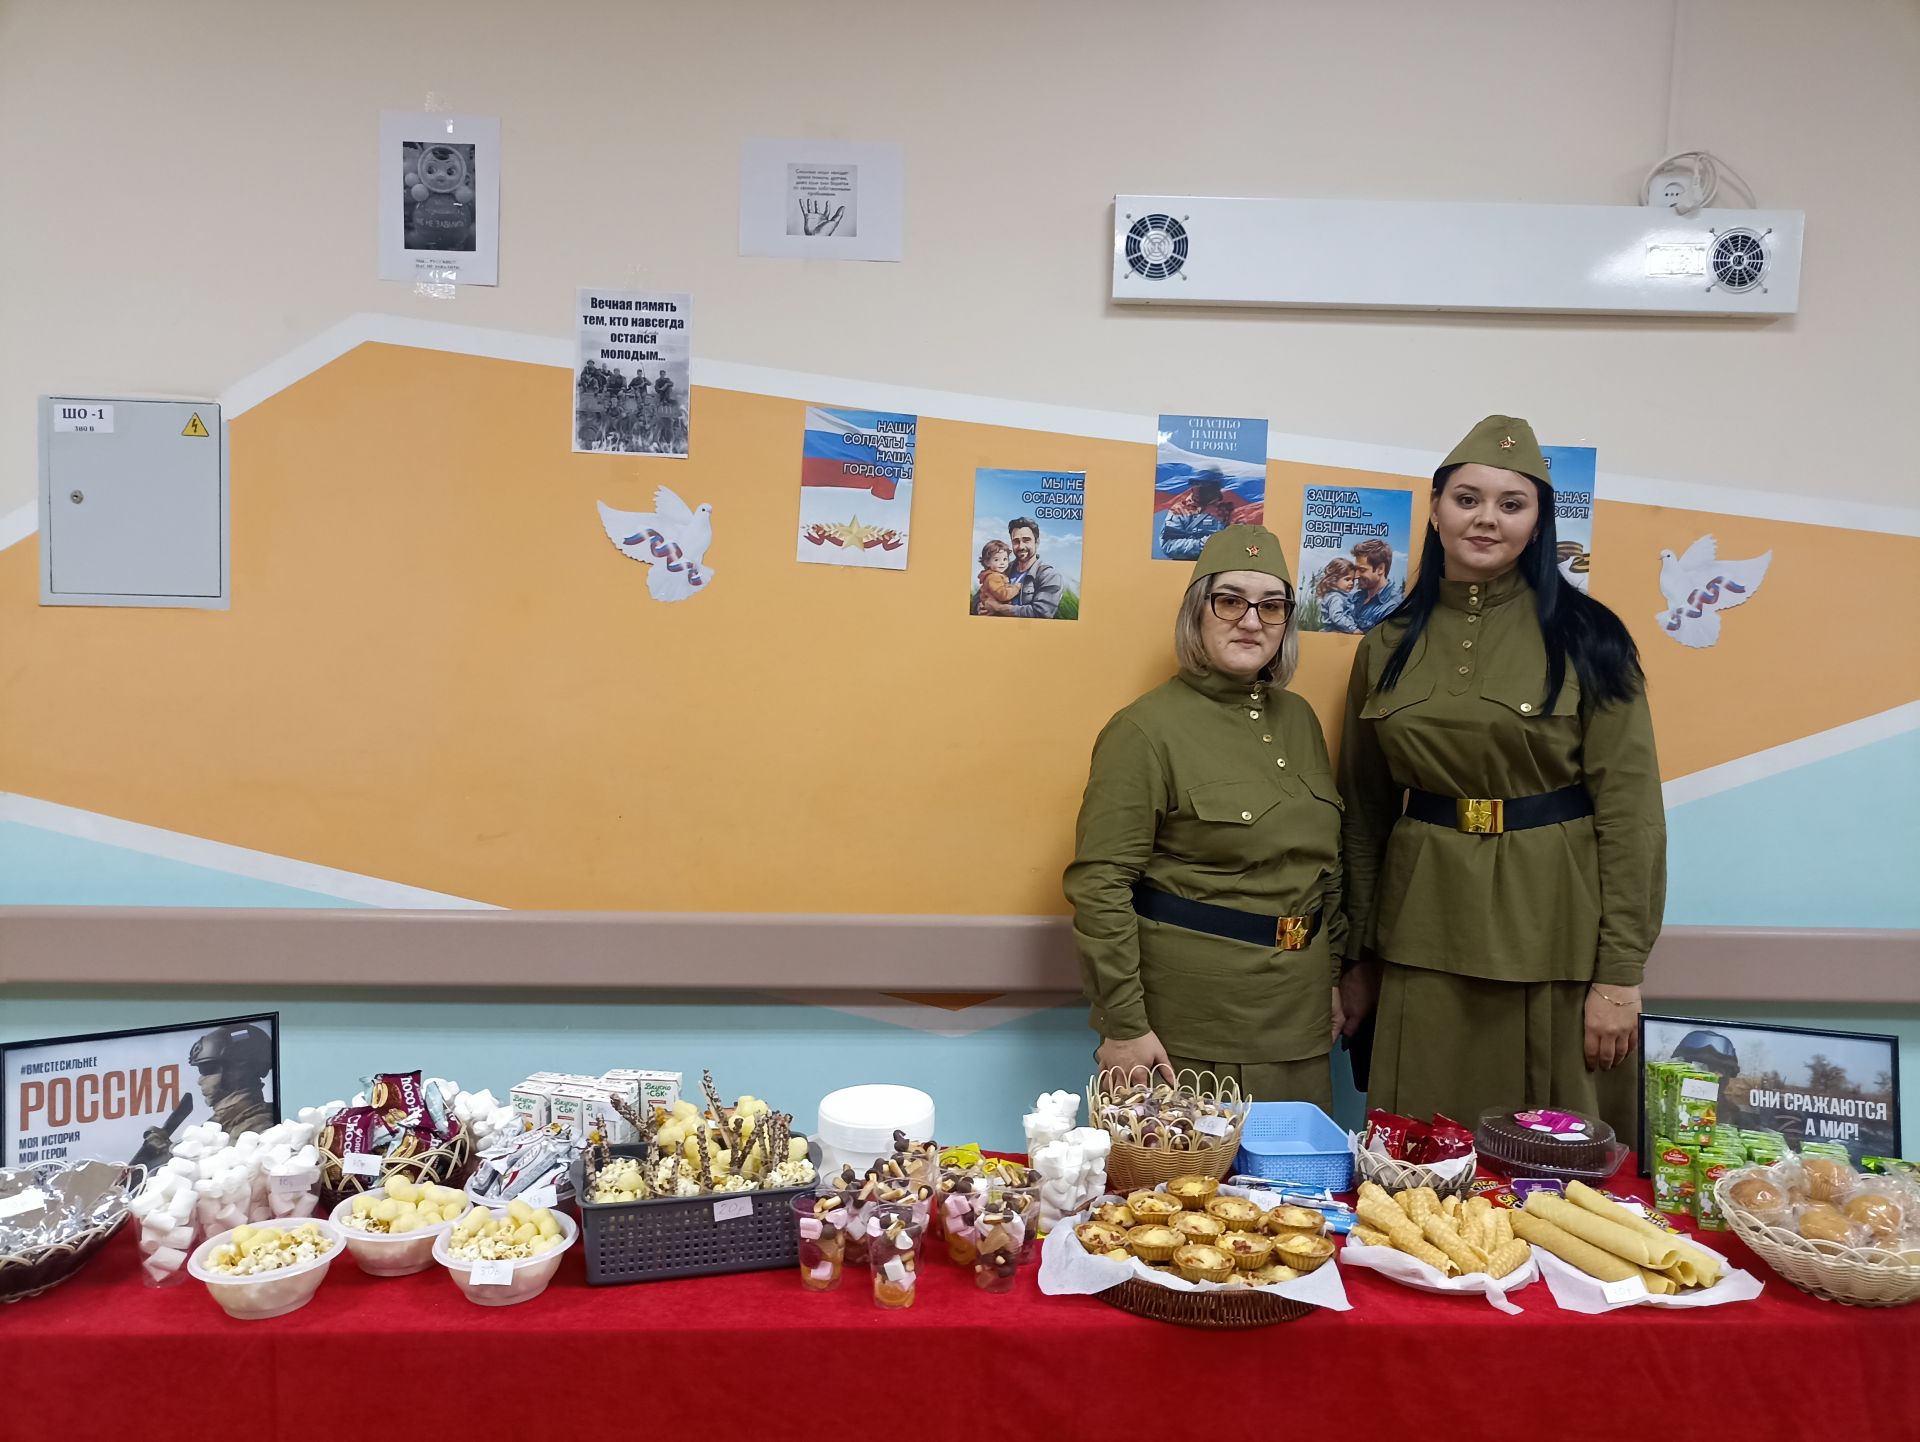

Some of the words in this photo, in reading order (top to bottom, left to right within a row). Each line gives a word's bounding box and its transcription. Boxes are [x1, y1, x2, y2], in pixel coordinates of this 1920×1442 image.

[590, 297, 633, 311] Вечная
[634, 300, 677, 313] память
[583, 314, 607, 327] тем,
[609, 316, 629, 327] кто
[631, 317, 684, 330] навсегда
[610, 332, 657, 344] остался
[600, 348, 666, 361] молодым...
[62, 407, 88, 420] ШО
[877, 420, 916, 435] НАШИ
[1188, 418, 1241, 429] СПАСИБО
[843, 433, 905, 448] СОЛДАТЫ
[1191, 429, 1237, 440] НАШИМ
[1190, 440, 1237, 452] ГЕРОЯМ!
[876, 450, 914, 464] НАША
[1041, 476, 1063, 490] МЫ
[1066, 478, 1085, 491] НЕ
[1022, 491, 1084, 505] ОСТАВИМ
[1307, 488, 1360, 504] ЗАЩИТА
[1554, 491, 1590, 504] ЬНАЯ
[1035, 506, 1083, 520] СВОИХ!
[1306, 503, 1361, 519] РОДИНЫ
[1306, 519, 1389, 537] СВЯЩЕННЫЙ
[1303, 534, 1342, 549] ДОЛГ!
[20, 1056, 98, 1075] #ВМЕСТЕСИЛЬНЕЕ
[19, 1064, 180, 1132] РОССИЯ
[1749, 1089, 1780, 1108] ОНИ
[1784, 1092, 1887, 1120] СРАЖАЮТСЯ
[1804, 1118, 1817, 1136] А
[1820, 1119, 1859, 1140] МИР!
[18, 1136, 39, 1150] МОЯ
[41, 1131, 81, 1147] ИСТОРИЯ
[18, 1150, 39, 1164] МОИ
[41, 1147, 67, 1160] ГЕРОИ
